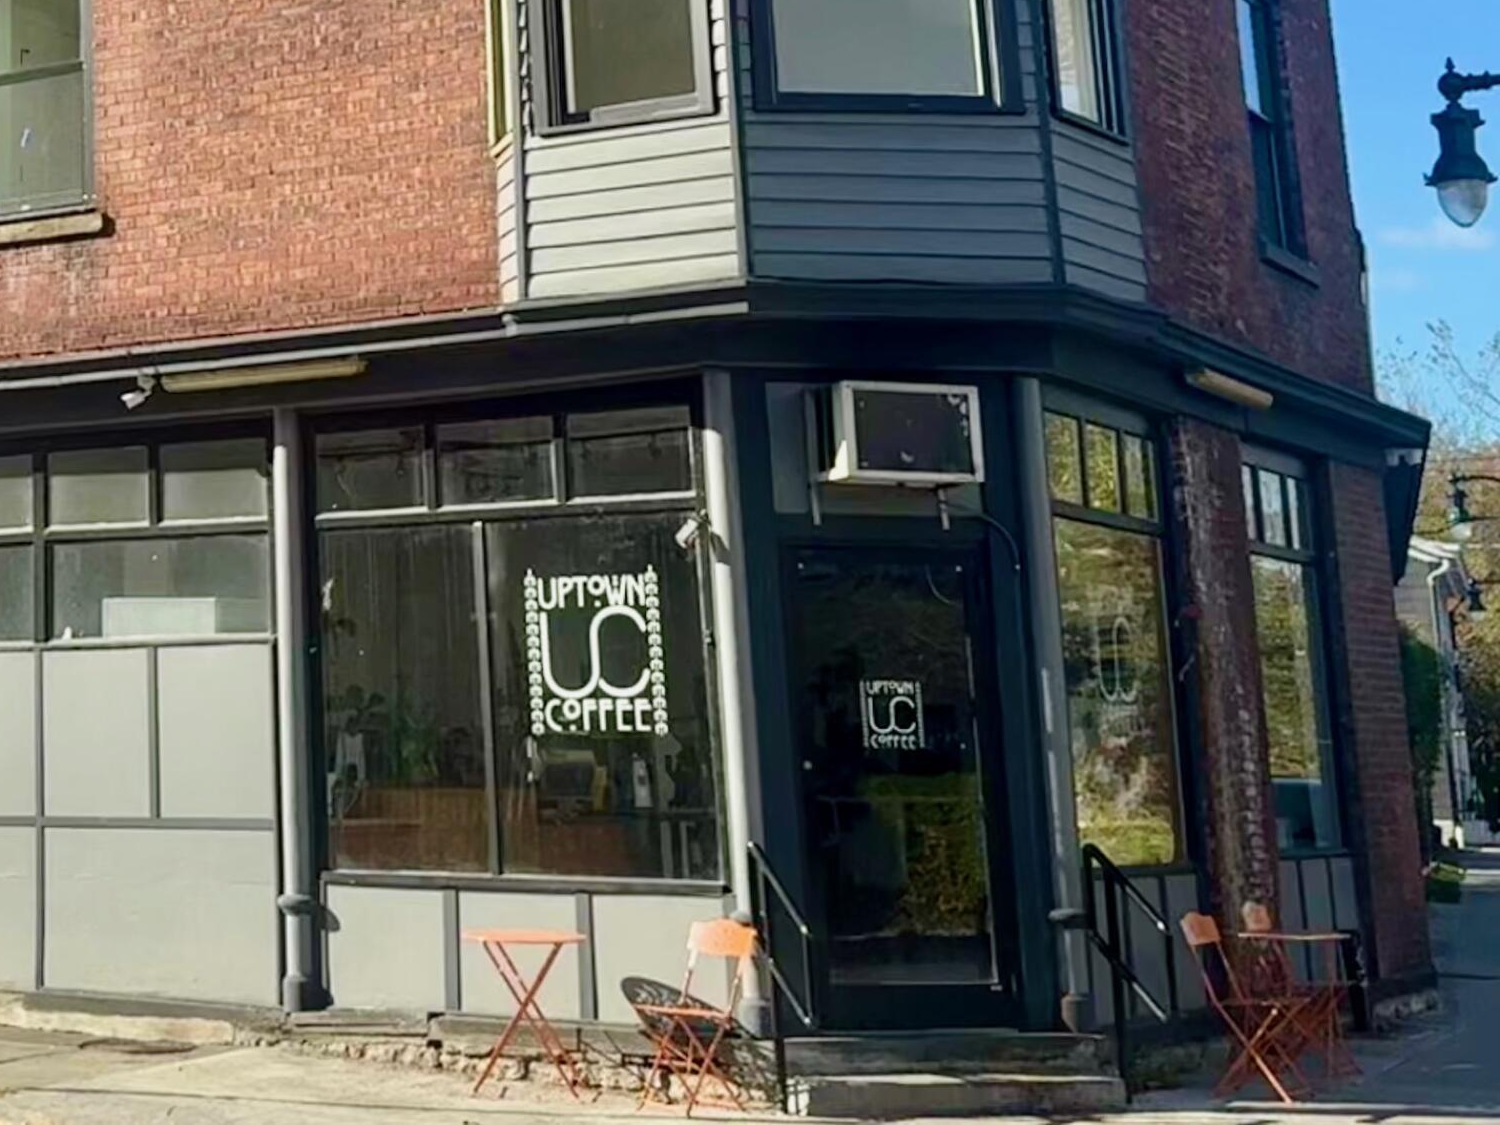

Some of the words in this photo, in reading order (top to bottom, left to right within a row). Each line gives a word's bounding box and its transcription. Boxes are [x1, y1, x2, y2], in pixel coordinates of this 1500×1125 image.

[537, 574, 646, 610] UPTOWN
[866, 680, 914, 694] UPTOWN
[545, 697, 652, 732] COFFEE
[870, 734, 916, 750] COFFEE
